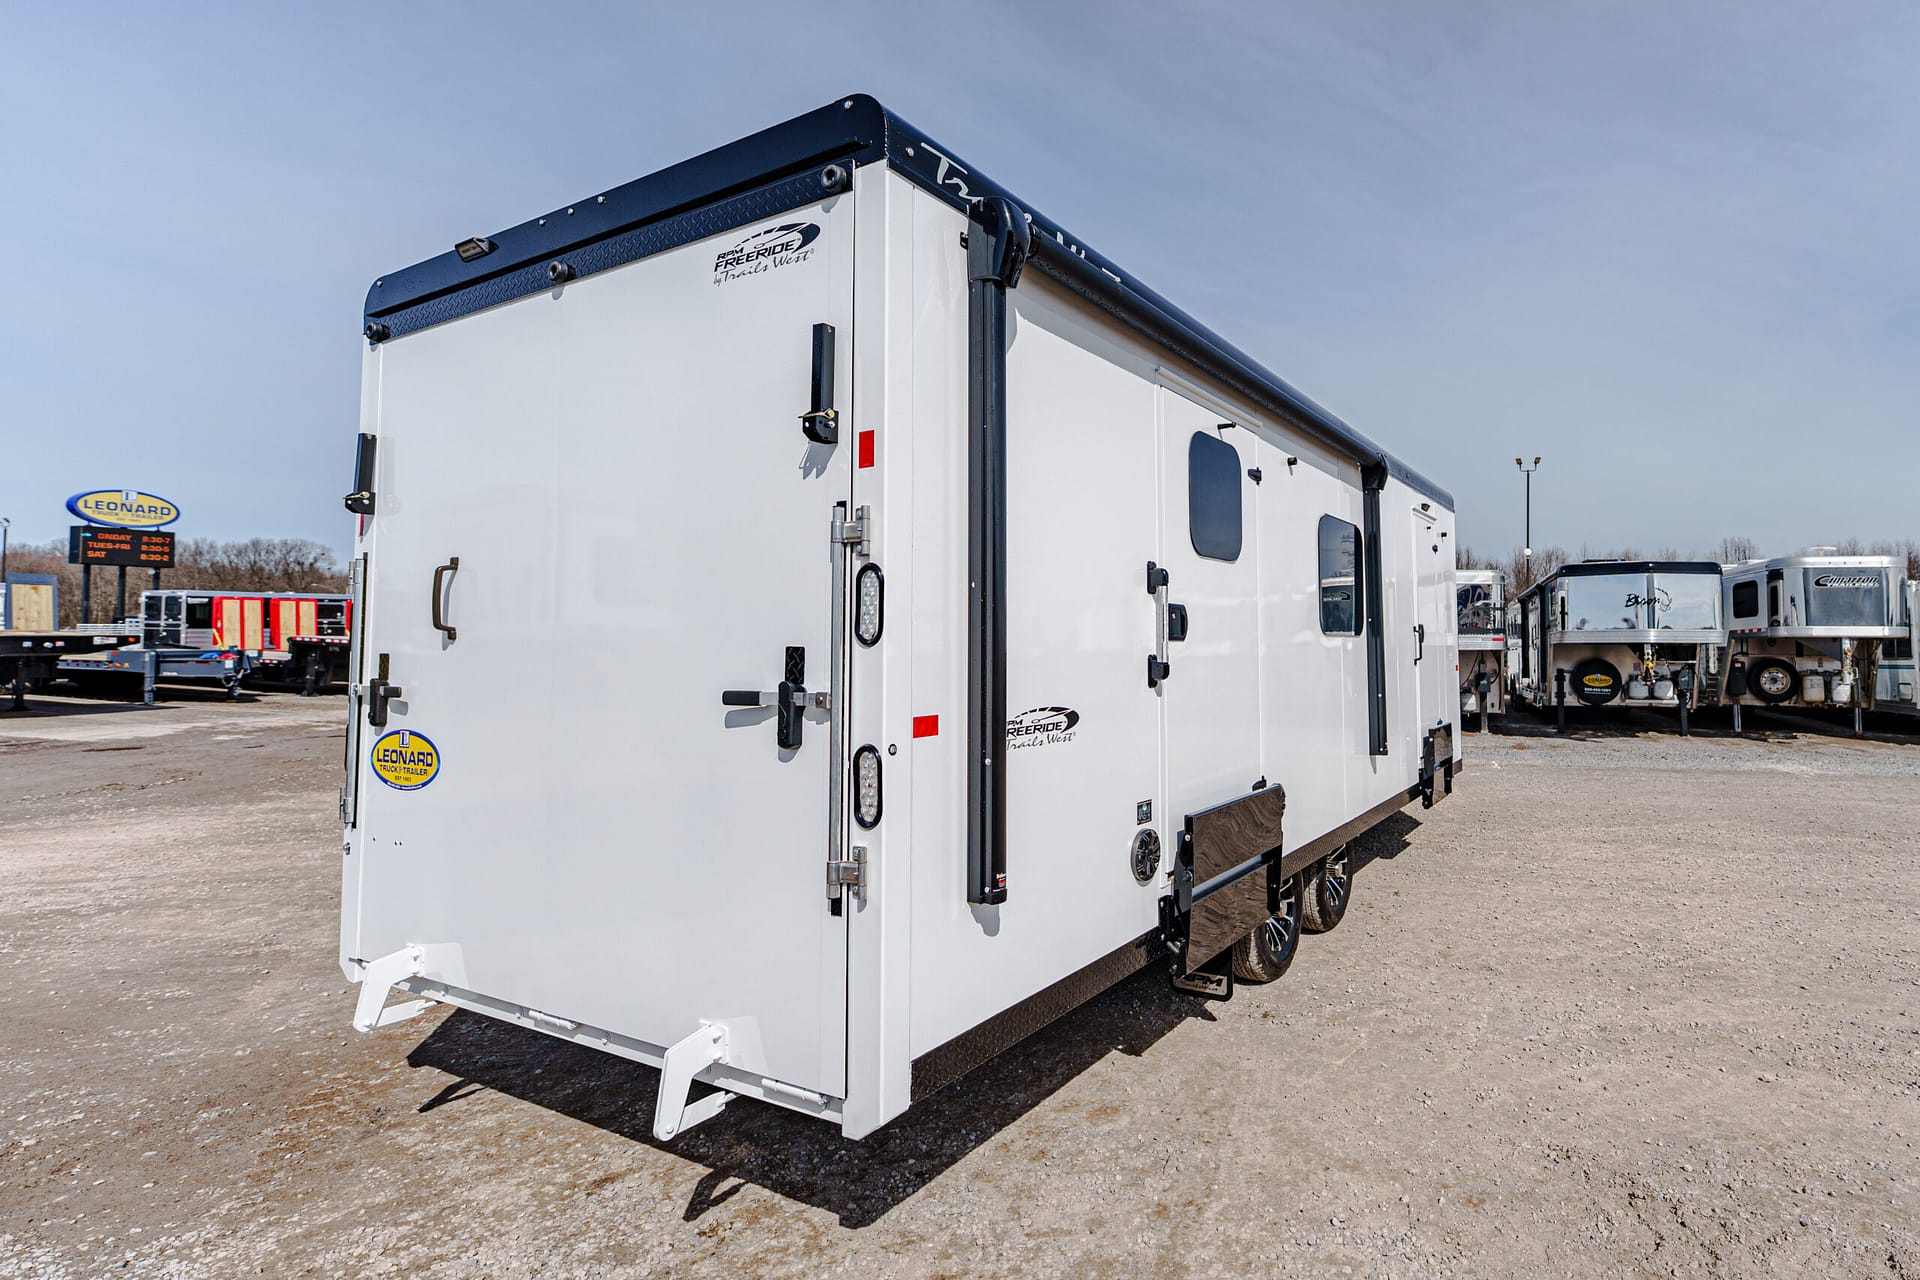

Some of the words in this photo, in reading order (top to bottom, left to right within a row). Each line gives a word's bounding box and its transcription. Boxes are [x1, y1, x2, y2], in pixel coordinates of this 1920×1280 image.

[714, 239, 796, 272] FREERIDE
[717, 247, 744, 260] RPM
[713, 274, 722, 287] by
[720, 261, 768, 282] Trails
[773, 250, 810, 269] West
[83, 499, 172, 516] LEONARD
[91, 509, 121, 518] TRUCK
[131, 512, 165, 521] TRAILER
[142, 535, 171, 544] 8:30-7
[87, 541, 131, 550] TUES-FRI
[141, 544, 170, 553] 8:30-5
[87, 550, 107, 558] SAT
[140, 553, 169, 561] 8:30-2
[1006, 721, 1064, 738] REERIDE
[1007, 719, 1024, 727] PM
[1046, 732, 1073, 745] West
[376, 747, 434, 767] LEONARD
[380, 764, 398, 773] TRUCK
[403, 767, 428, 776] TRAILER
